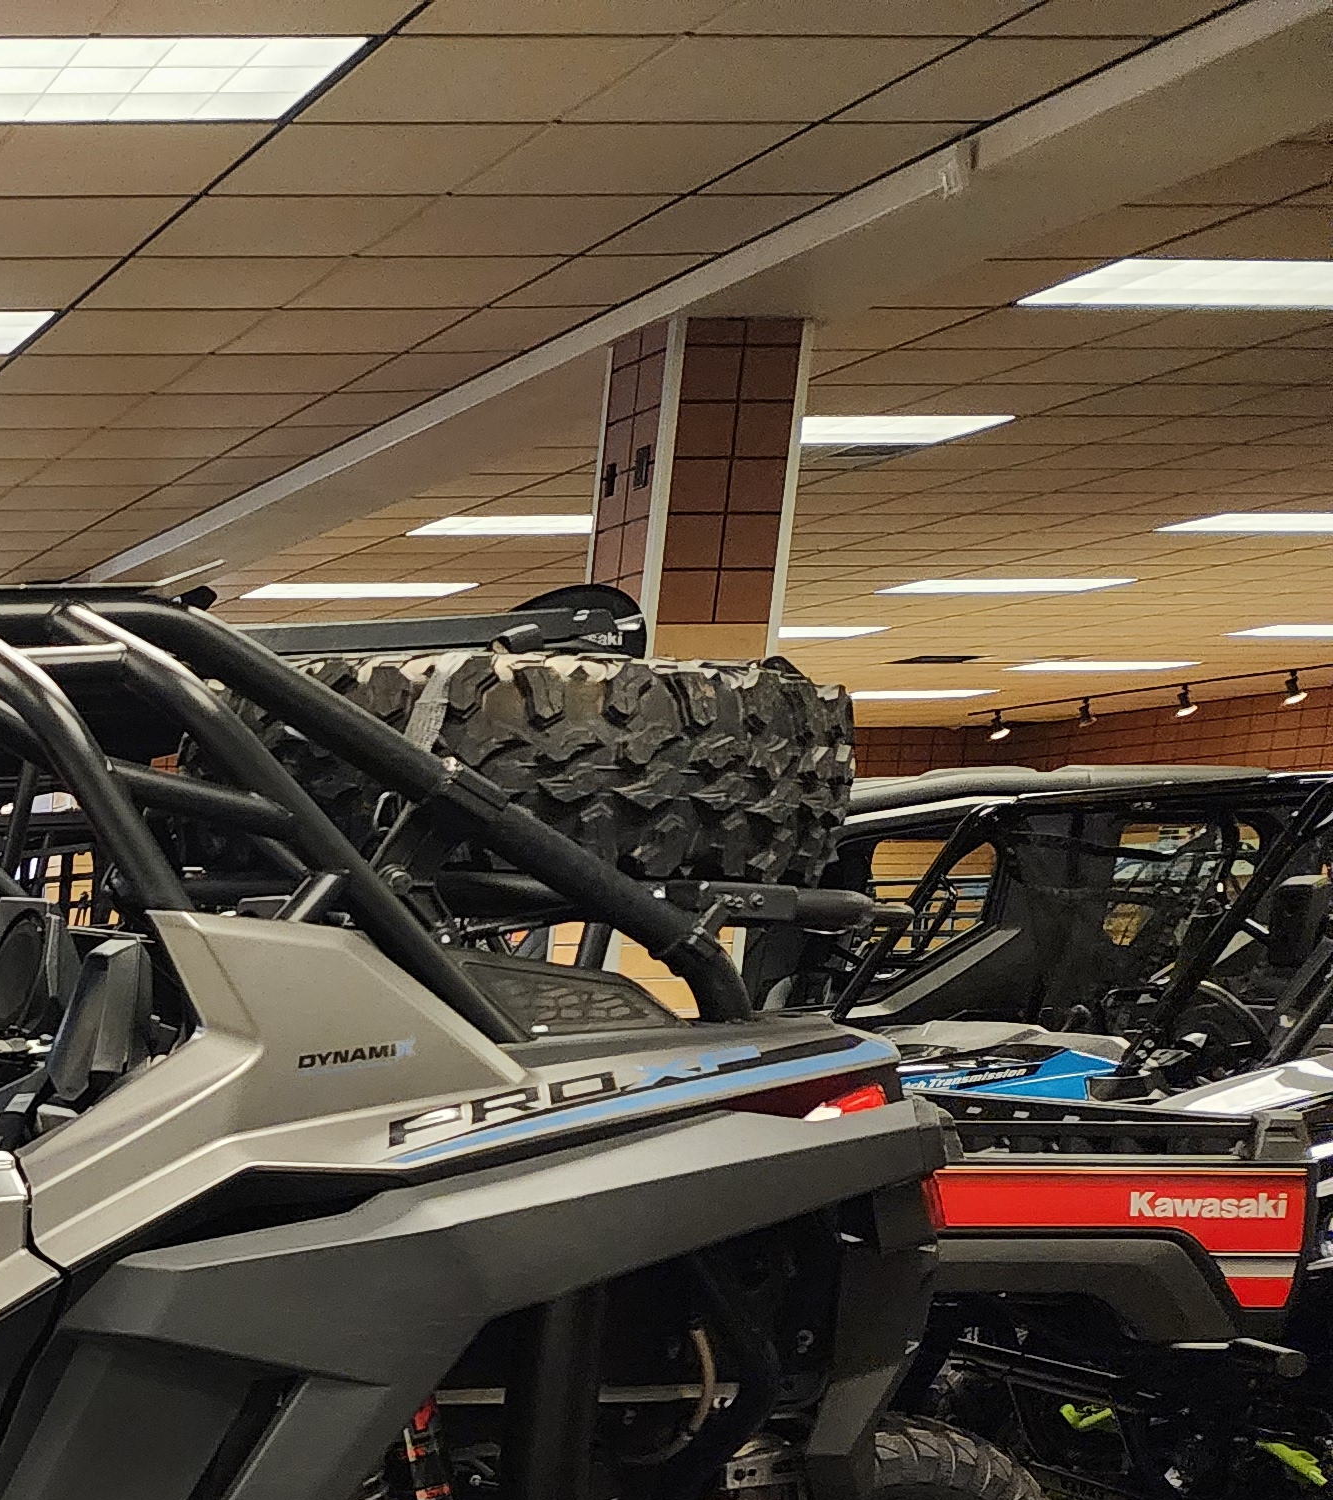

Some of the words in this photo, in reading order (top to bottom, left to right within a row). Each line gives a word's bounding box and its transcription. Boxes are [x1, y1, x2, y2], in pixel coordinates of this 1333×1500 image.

[579, 631, 624, 646] saki
[929, 1068, 1028, 1088] Transmission
[1129, 1191, 1288, 1219] Kawasaki
